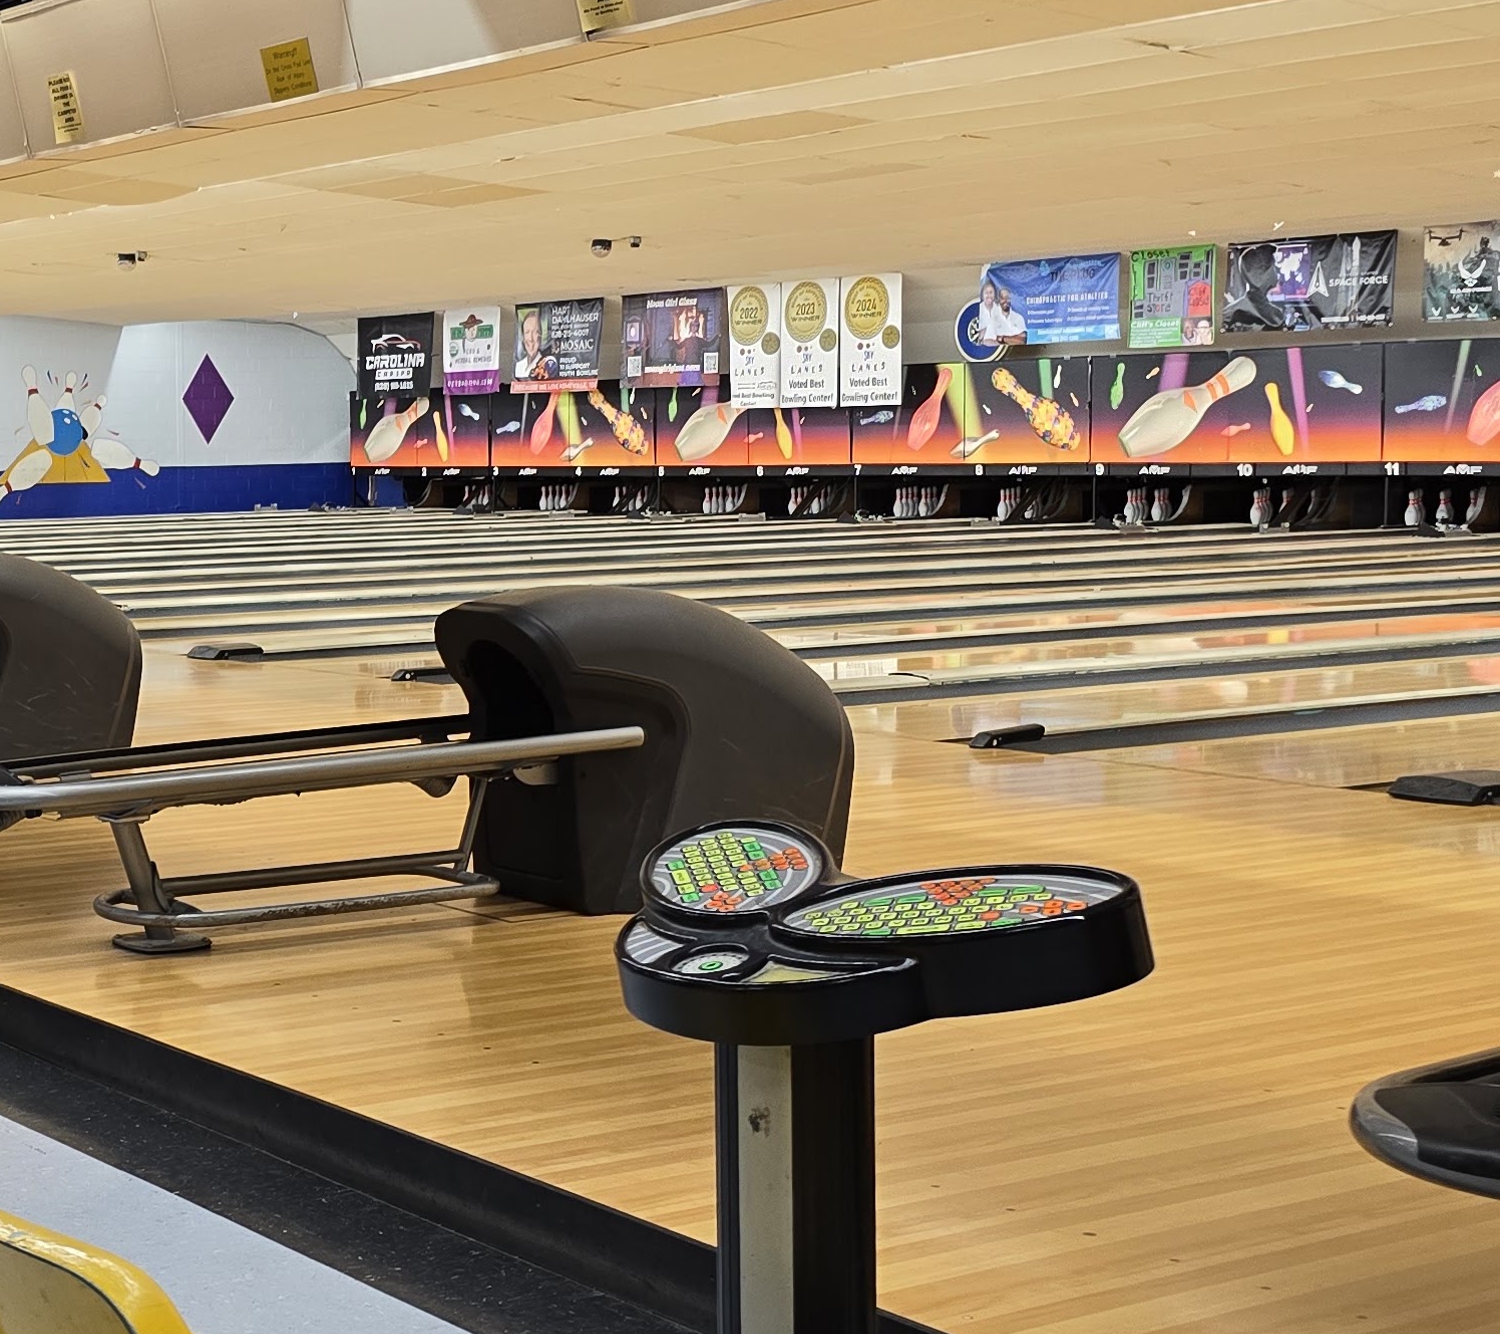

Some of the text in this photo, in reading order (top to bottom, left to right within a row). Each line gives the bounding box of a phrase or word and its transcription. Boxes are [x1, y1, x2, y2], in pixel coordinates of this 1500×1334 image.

[1329, 275, 1388, 287] SPACE FORCE
[1147, 291, 1173, 303] Thrift
[796, 302, 815, 315] 2023
[856, 298, 876, 312] 2024
[740, 307, 758, 319] 2022
[561, 339, 594, 350] MOSAIC
[365, 353, 426, 370] CAROLINA
[734, 367, 764, 376] LANES
[791, 364, 823, 374] LANES
[852, 362, 885, 373] LANES
[789, 379, 824, 389] Voted Best
[849, 377, 887, 387] Voted Best
[782, 393, 834, 405] Bowling Center!
[842, 391, 897, 403] Bowling Center!
[422, 467, 427, 476] 2
[493, 467, 499, 476] 3
[575, 467, 581, 476] 4
[600, 467, 620, 475] AMF
[658, 467, 664, 476] 5
[688, 467, 710, 475] AMF
[756, 467, 763, 476] 6
[785, 467, 809, 475] AMF
[854, 465, 862, 475] 7
[891, 467, 918, 475] AMF
[975, 465, 983, 475] 8
[1009, 466, 1037, 475] AMF
[1096, 464, 1104, 475] 9
[1139, 466, 1170, 475] AMF
[1237, 464, 1252, 476] 10
[1282, 465, 1318, 475] AMF
[1385, 462, 1399, 475] 11
[1442, 465, 1482, 475] AMF
